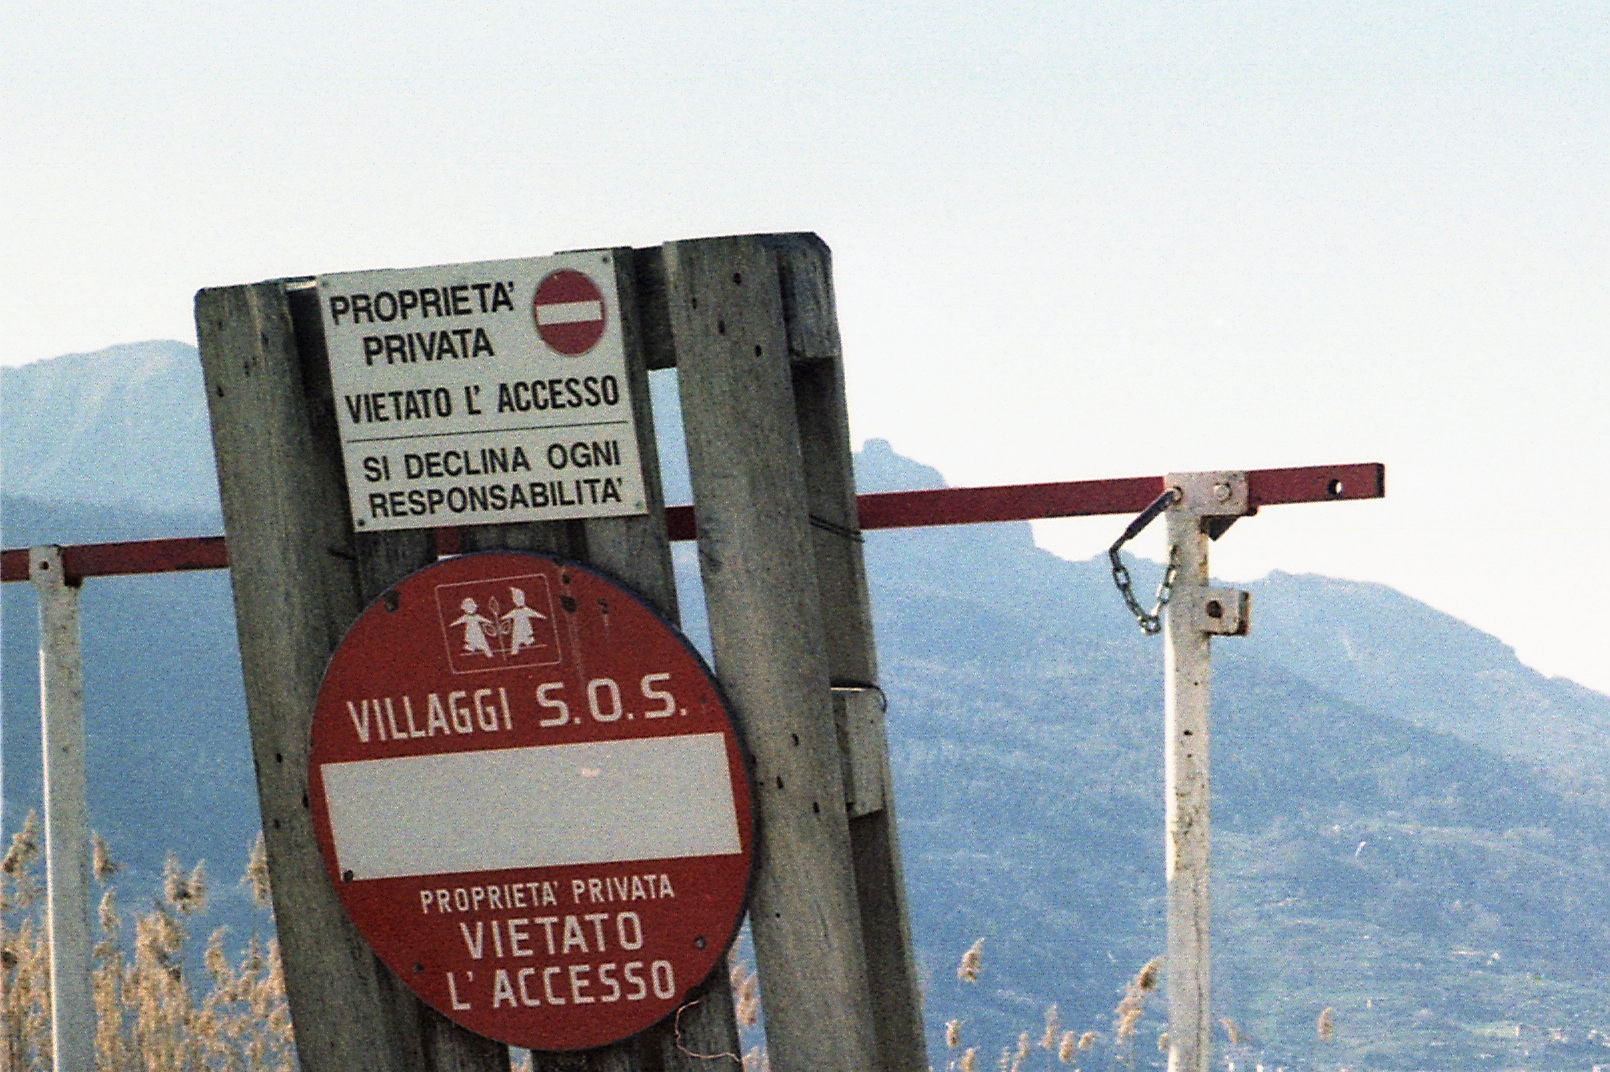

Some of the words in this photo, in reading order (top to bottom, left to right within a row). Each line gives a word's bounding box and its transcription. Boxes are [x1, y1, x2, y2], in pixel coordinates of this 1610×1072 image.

[329, 281, 515, 326] PROPRIETA'
[362, 327, 495, 366] PRIVATA
[345, 387, 452, 424] VIETATO
[464, 385, 481, 415] L'
[497, 375, 620, 413] ACCESSO
[363, 455, 390, 482] SI
[404, 446, 531, 480] DECLINA
[547, 440, 621, 470] OGNI
[368, 477, 623, 518] RESPONSABILITA'
[347, 687, 513, 743] VILLAGGI
[536, 673, 687, 727] S.O.S.
[420, 881, 558, 914] PROPRIETA'
[571, 874, 675, 904] PRIVATA
[460, 911, 644, 960] VIETATO
[446, 970, 474, 1010] L'
[493, 960, 675, 1008] ACCESSO
